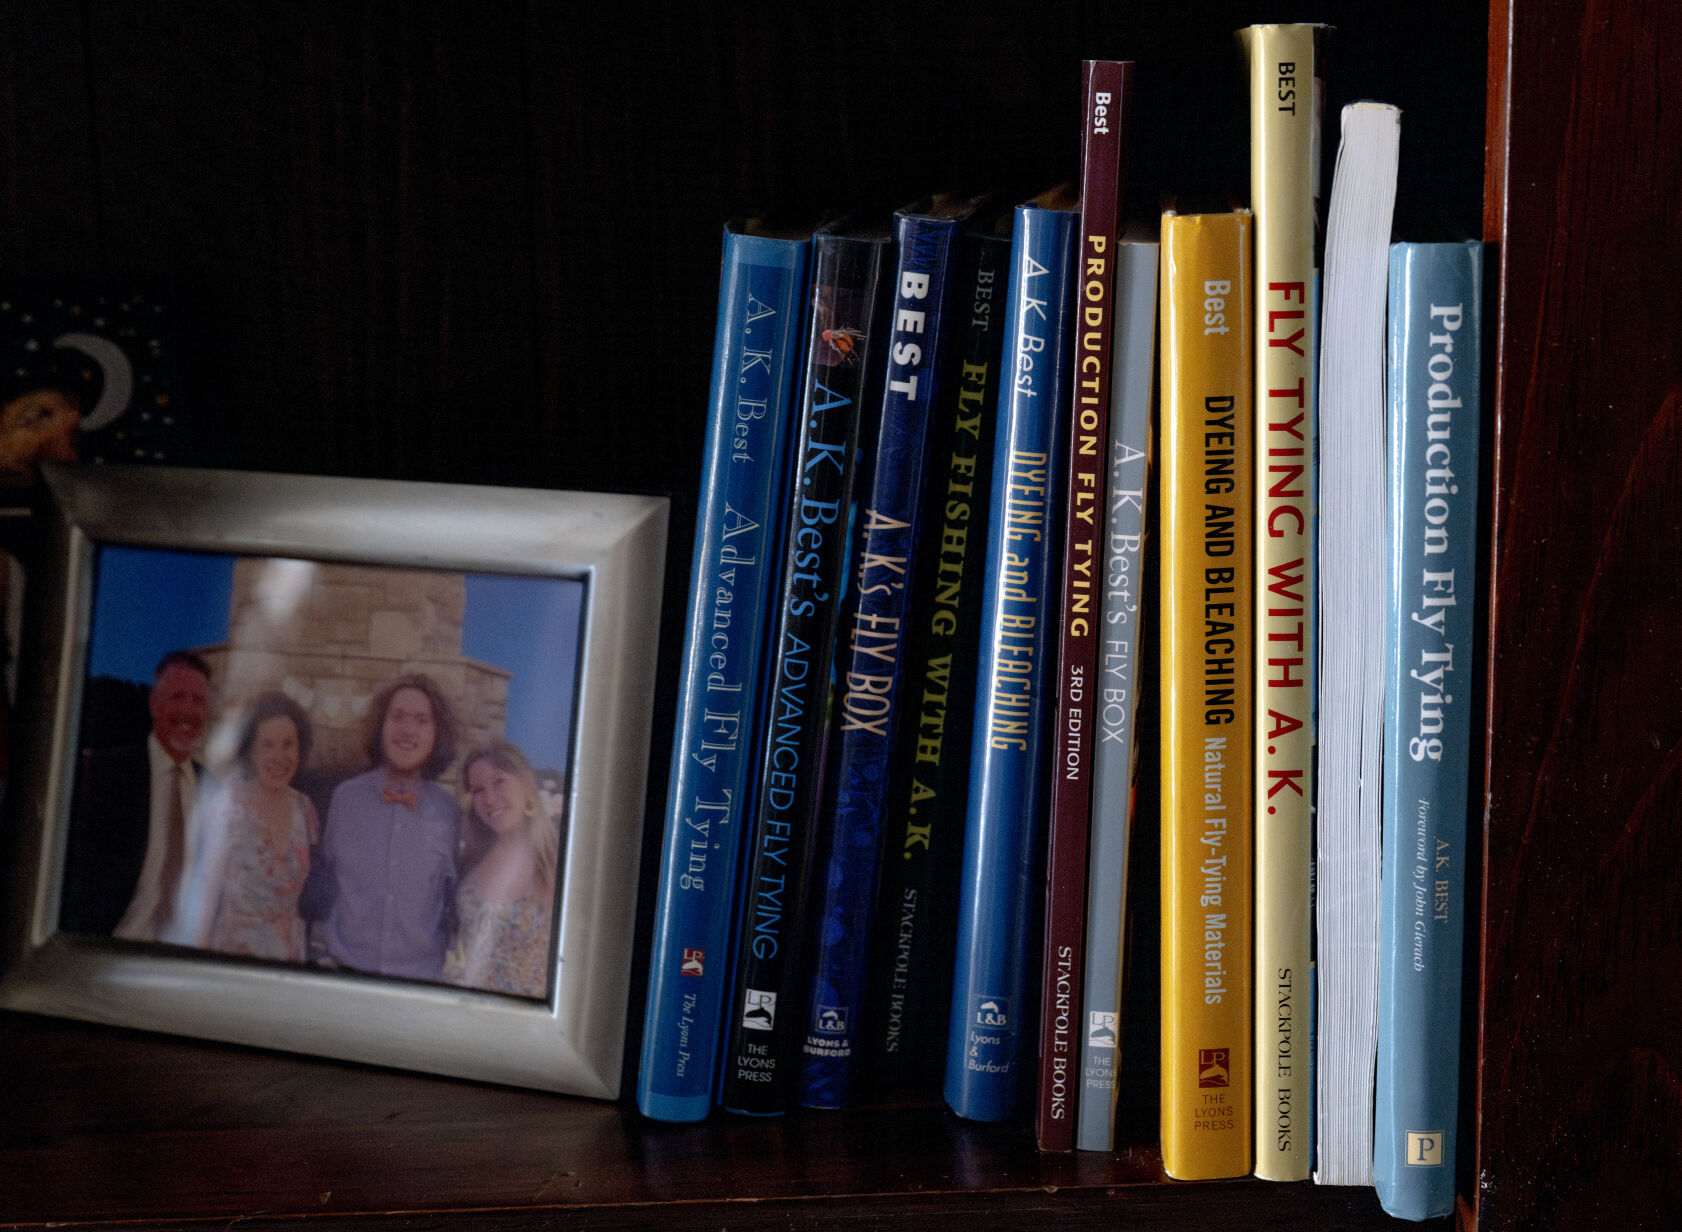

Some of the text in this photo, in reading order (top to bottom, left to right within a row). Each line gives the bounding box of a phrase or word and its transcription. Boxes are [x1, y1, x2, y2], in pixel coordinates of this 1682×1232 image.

[1094, 92, 1112, 135] Best
[1277, 61, 1296, 116] BEST
[972, 270, 995, 332] BEST
[1203, 279, 1230, 336] Best
[1268, 282, 1305, 358] FLY
[889, 271, 930, 400] BEST
[1015, 334, 1045, 397] Best
[732, 394, 768, 464] Best
[955, 359, 987, 440] FLY
[1069, 235, 1106, 638] PRODUCTION FLY TYING
[1267, 379, 1305, 538] TYING
[932, 451, 977, 635] FISHING
[1203, 395, 1235, 726] DYEING AND BLEACHING
[1410, 303, 1463, 762] Production Fly Tying
[990, 451, 1047, 751] DYEING and BLEACHING
[1267, 557, 1304, 688] WITH
[850, 613, 900, 663] FLY
[1105, 640, 1128, 680] FLY
[680, 501, 760, 892] Advanced Fly Tying
[769, 631, 810, 810] ADVANCED
[840, 672, 893, 737] BOX
[915, 653, 952, 766] WITH
[1065, 665, 1083, 780] 3RD EDITION
[1101, 688, 1125, 744] BOX
[762, 819, 791, 867] FLY
[1199, 737, 1227, 1005] Natural Fly-Tying Materials
[1412, 798, 1430, 972] Foreword by John Gierach
[1434, 880, 1449, 923] BEST
[753, 873, 788, 960] TYING
[886, 888, 918, 1052] STACKPOLE BOOKS
[676, 993, 697, 1078] The Lyons Press
[807, 1036, 839, 1048] LYONS
[818, 1019, 845, 1030] L&B
[970, 1031, 1000, 1045] Lyons
[977, 1012, 1006, 1026] L&B
[1051, 945, 1072, 1120] STACKPOLE BOOKS
[737, 1055, 776, 1068] LYONS
[737, 1069, 772, 1082] PRESS
[748, 1043, 768, 1056] THE
[968, 1058, 1009, 1073] Burford
[969, 1046, 979, 1058] &
[1085, 1067, 1117, 1078] LYONS
[1093, 1056, 1112, 1066] THE
[1201, 1050, 1225, 1066] LP
[1277, 967, 1292, 1152] STACKPOLE BOOKS
[1086, 1079, 1116, 1089] PRESS
[1195, 1106, 1234, 1117] LYONS
[1202, 1094, 1226, 1104] THE
[1194, 1120, 1234, 1131] PRESS
[1417, 1137, 1434, 1161] P
